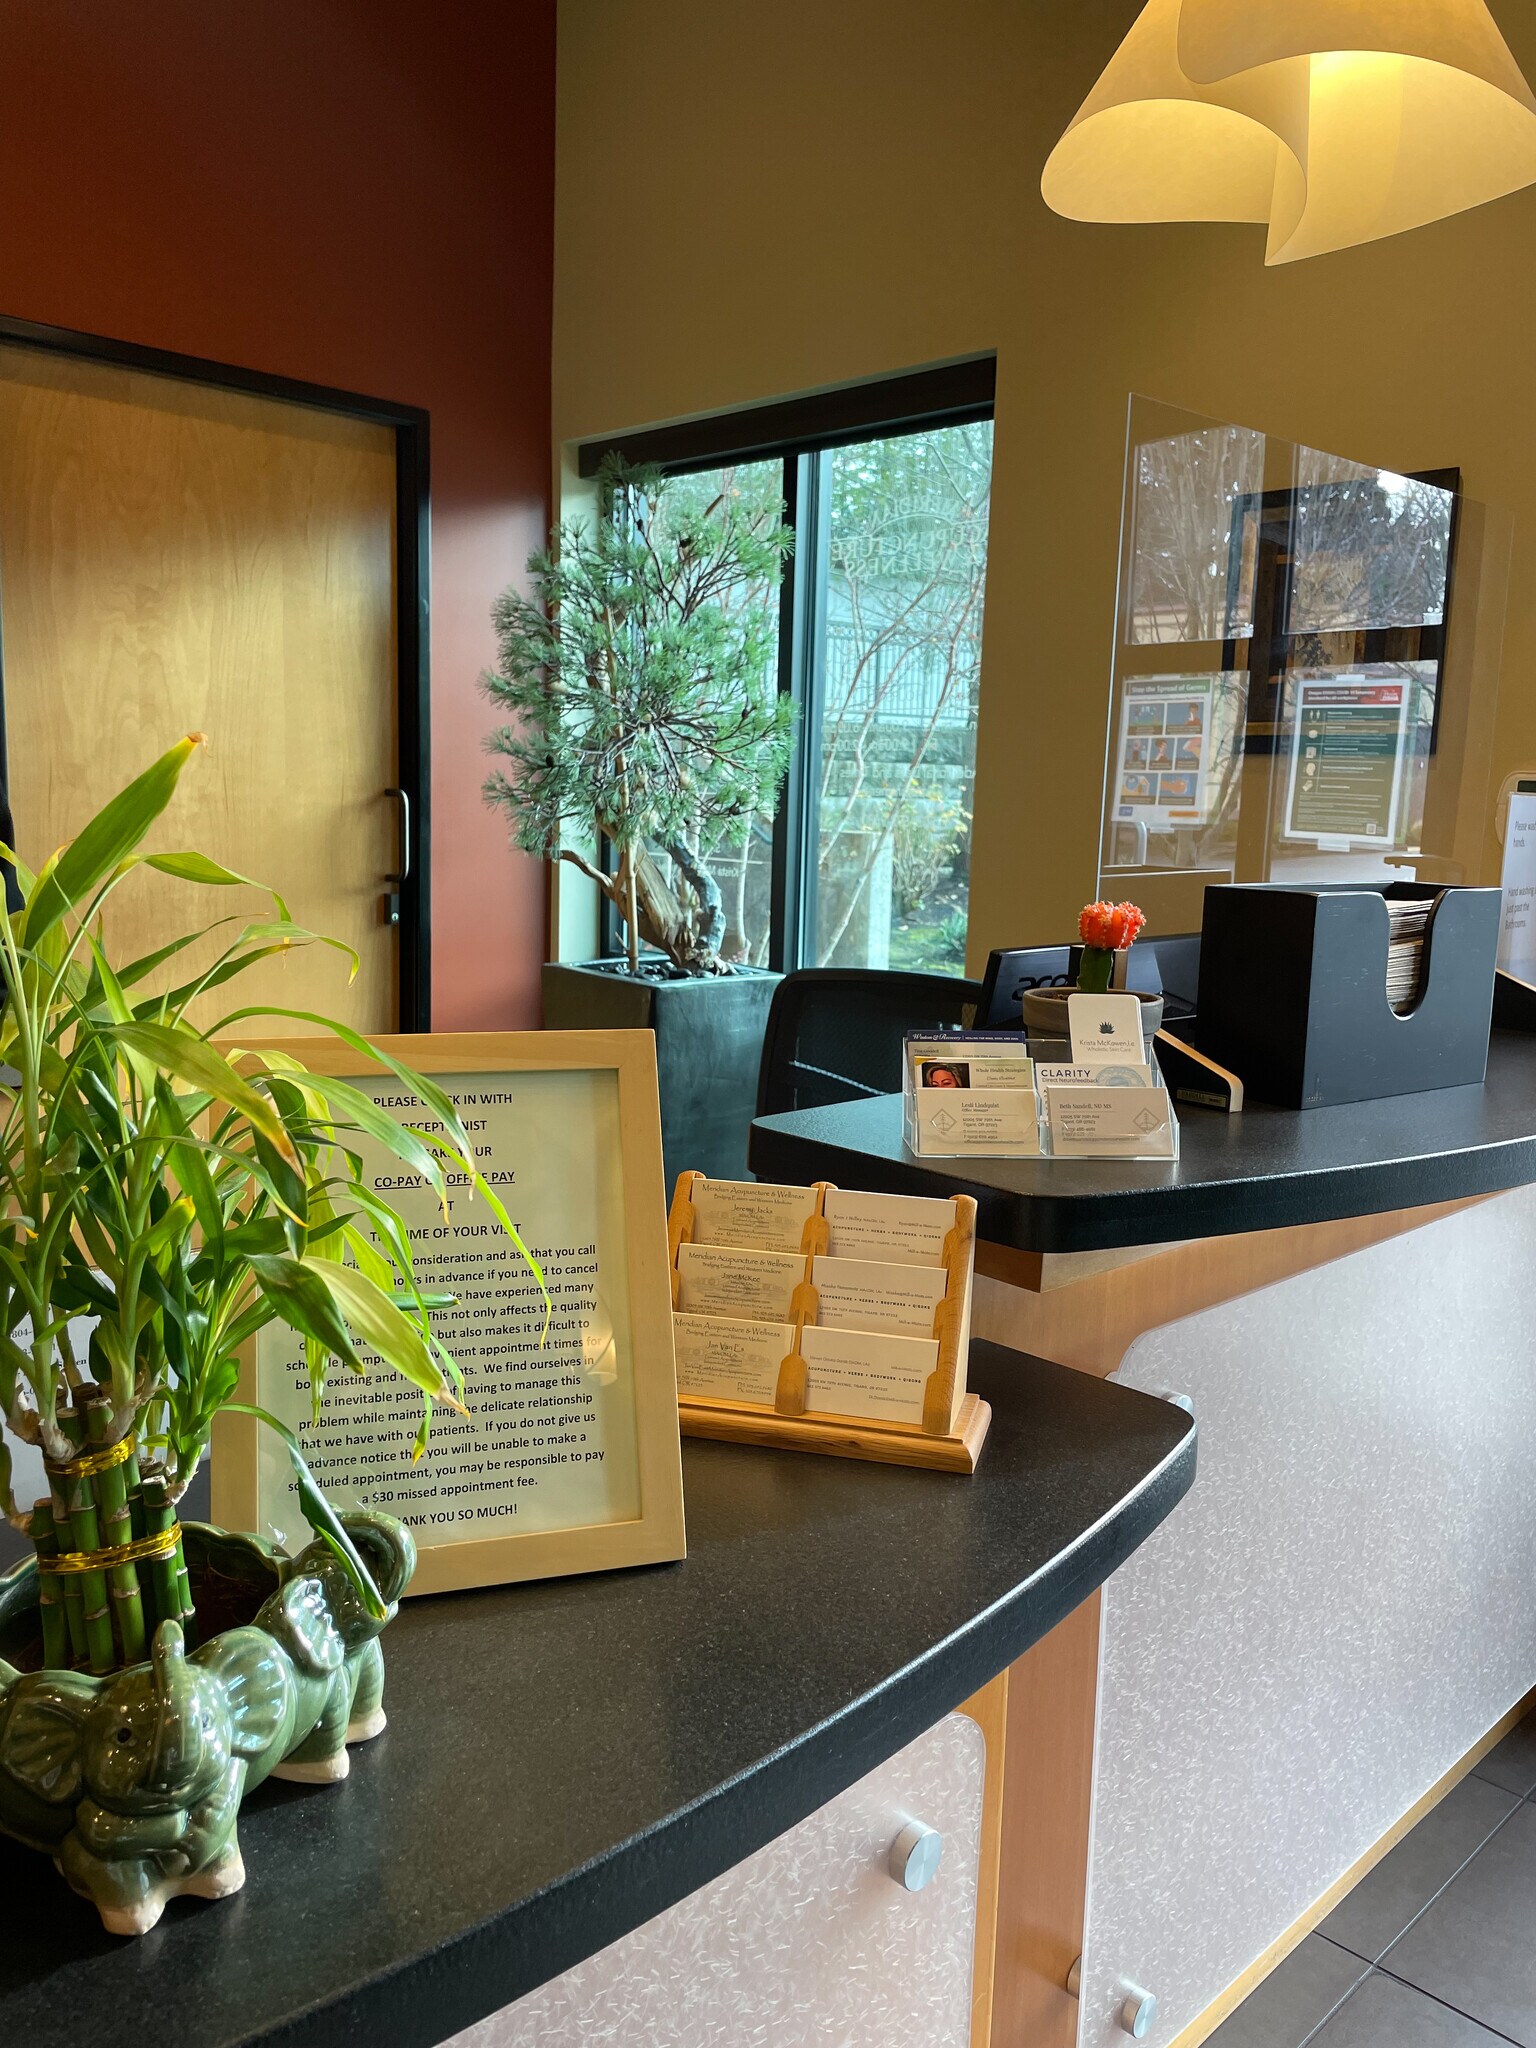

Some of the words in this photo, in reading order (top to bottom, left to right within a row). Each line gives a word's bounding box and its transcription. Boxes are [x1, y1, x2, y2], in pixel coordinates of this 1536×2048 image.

[1157, 685, 1178, 693] Spread
[1041, 1069, 1091, 1077] CLARITY
[373, 1097, 417, 1107] PLEASE
[463, 1094, 477, 1105] IN
[480, 1094, 512, 1104] WITH
[374, 1176, 422, 1188] CO-PAY
[492, 1171, 515, 1182] PAY
[702, 1184, 729, 1192] Meridian
[777, 1190, 805, 1199] Wellness
[731, 1204, 754, 1214] Jeremy
[433, 1228, 449, 1238] OF
[453, 1226, 487, 1237] YOUR
[486, 1251, 506, 1260] and
[555, 1248, 574, 1258] you
[578, 1245, 595, 1254] call
[689, 1252, 716, 1261] Meridian
[718, 1255, 758, 1265] Acupuncture
[767, 1260, 794, 1268] Wellness
[425, 1274, 435, 1283] in
[439, 1272, 484, 1282] advance
[488, 1270, 495, 1279] if
[498, 1270, 518, 1280] you
[551, 1267, 562, 1275] to
[565, 1263, 598, 1273] cancel
[466, 1290, 492, 1299] have
[565, 1284, 594, 1293] many
[452, 1310, 470, 1319] not
[473, 1307, 496, 1318] only
[500, 1304, 536, 1317] affects
[560, 1300, 597, 1313] quality
[437, 1330, 456, 1339] but
[460, 1328, 482, 1337] also
[485, 1325, 520, 1336] makes
[523, 1323, 531, 1333] it
[578, 1320, 589, 1328] to
[674, 1318, 702, 1328] Meridian
[752, 1327, 780, 1338] Wellness
[554, 1339, 583, 1349] times
[586, 1336, 602, 1345] for
[706, 1341, 718, 1349] Jan
[720, 1342, 732, 1350] Van
[734, 1343, 744, 1352] Es
[327, 1374, 372, 1387] existing
[375, 1372, 397, 1383] and
[484, 1363, 502, 1373] We
[506, 1361, 526, 1371] find
[530, 1357, 581, 1369] ourselves
[584, 1356, 594, 1364] in
[808, 1366, 841, 1374] ACUPUNCTURE
[335, 1389, 392, 1406] inevitable
[500, 1383, 511, 1391] to
[515, 1379, 558, 1390] manage
[561, 1375, 581, 1385] this
[353, 1412, 384, 1424] while
[481, 1400, 524, 1412] delicate
[528, 1393, 592, 1408] relationship
[325, 1438, 342, 1446] we
[346, 1435, 373, 1445] have
[377, 1430, 403, 1442] with
[430, 1424, 478, 1439] patients.
[486, 1421, 493, 1431] If
[496, 1422, 516, 1433] you
[520, 1418, 534, 1428] do
[538, 1416, 555, 1426] not
[559, 1414, 580, 1426] give
[584, 1413, 596, 1421] us
[308, 1455, 357, 1469] advance
[361, 1452, 397, 1464] notice
[427, 1448, 448, 1459] you
[451, 1443, 471, 1454] will
[475, 1442, 488, 1451] be
[492, 1438, 529, 1450] unable
[533, 1437, 544, 1446] to
[548, 1433, 576, 1445] make
[353, 1469, 432, 1487] appointment,
[436, 1466, 456, 1478] you
[460, 1463, 484, 1473] may
[487, 1460, 501, 1470] be
[504, 1453, 567, 1469] responsible
[570, 1453, 582, 1461] to
[585, 1451, 604, 1462] pay
[372, 1491, 394, 1504] $30
[397, 1486, 437, 1500] missed
[441, 1479, 514, 1497] appointment
[517, 1476, 538, 1487] fee.
[430, 1511, 455, 1524] YOU
[458, 1509, 473, 1520] SO
[477, 1504, 517, 1518] MUCH!
